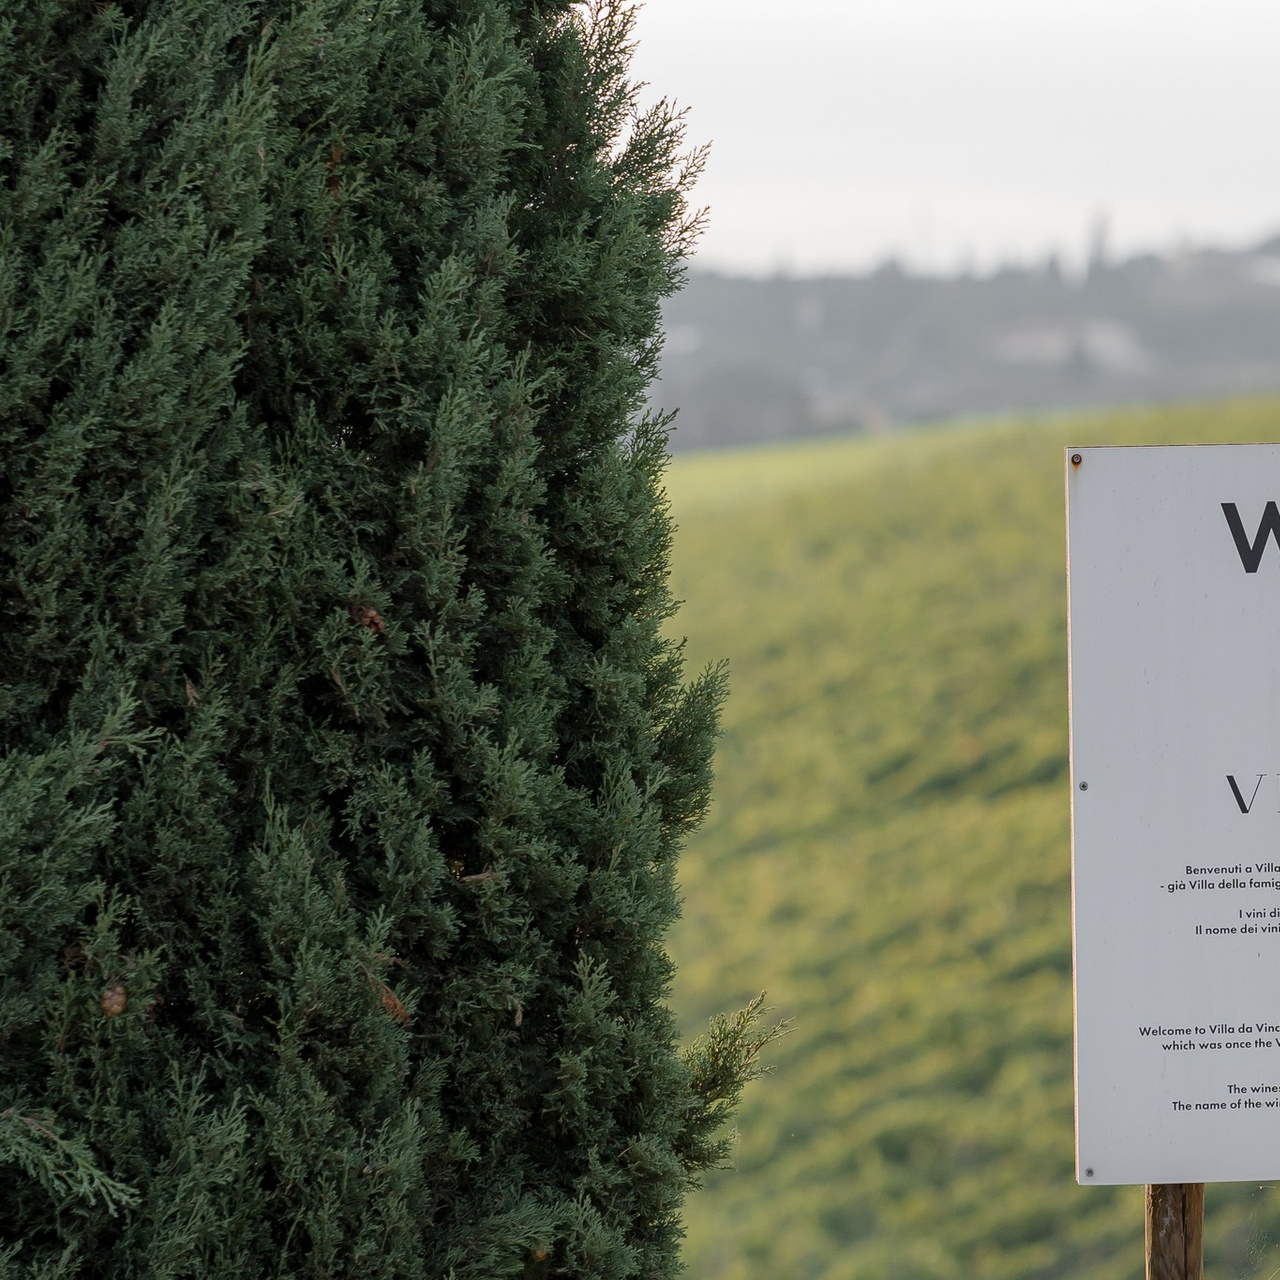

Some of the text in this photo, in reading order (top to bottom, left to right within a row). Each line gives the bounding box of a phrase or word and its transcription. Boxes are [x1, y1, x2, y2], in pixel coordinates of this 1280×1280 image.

[1186, 863, 1242, 875] Benvenuti
[1255, 862, 1280, 873] Villa
[1245, 908, 1266, 918] vini
[1269, 907, 1280, 918] di
[1139, 1025, 1192, 1036] Welcome
[1194, 1026, 1206, 1035] to
[1209, 1024, 1235, 1034] Villa
[1238, 1023, 1253, 1034] da
[1227, 1084, 1247, 1094] The
[1172, 1100, 1192, 1111] The
[1195, 1102, 1227, 1110] name
[1230, 1098, 1242, 1109] of
[1244, 1098, 1262, 1109] the
